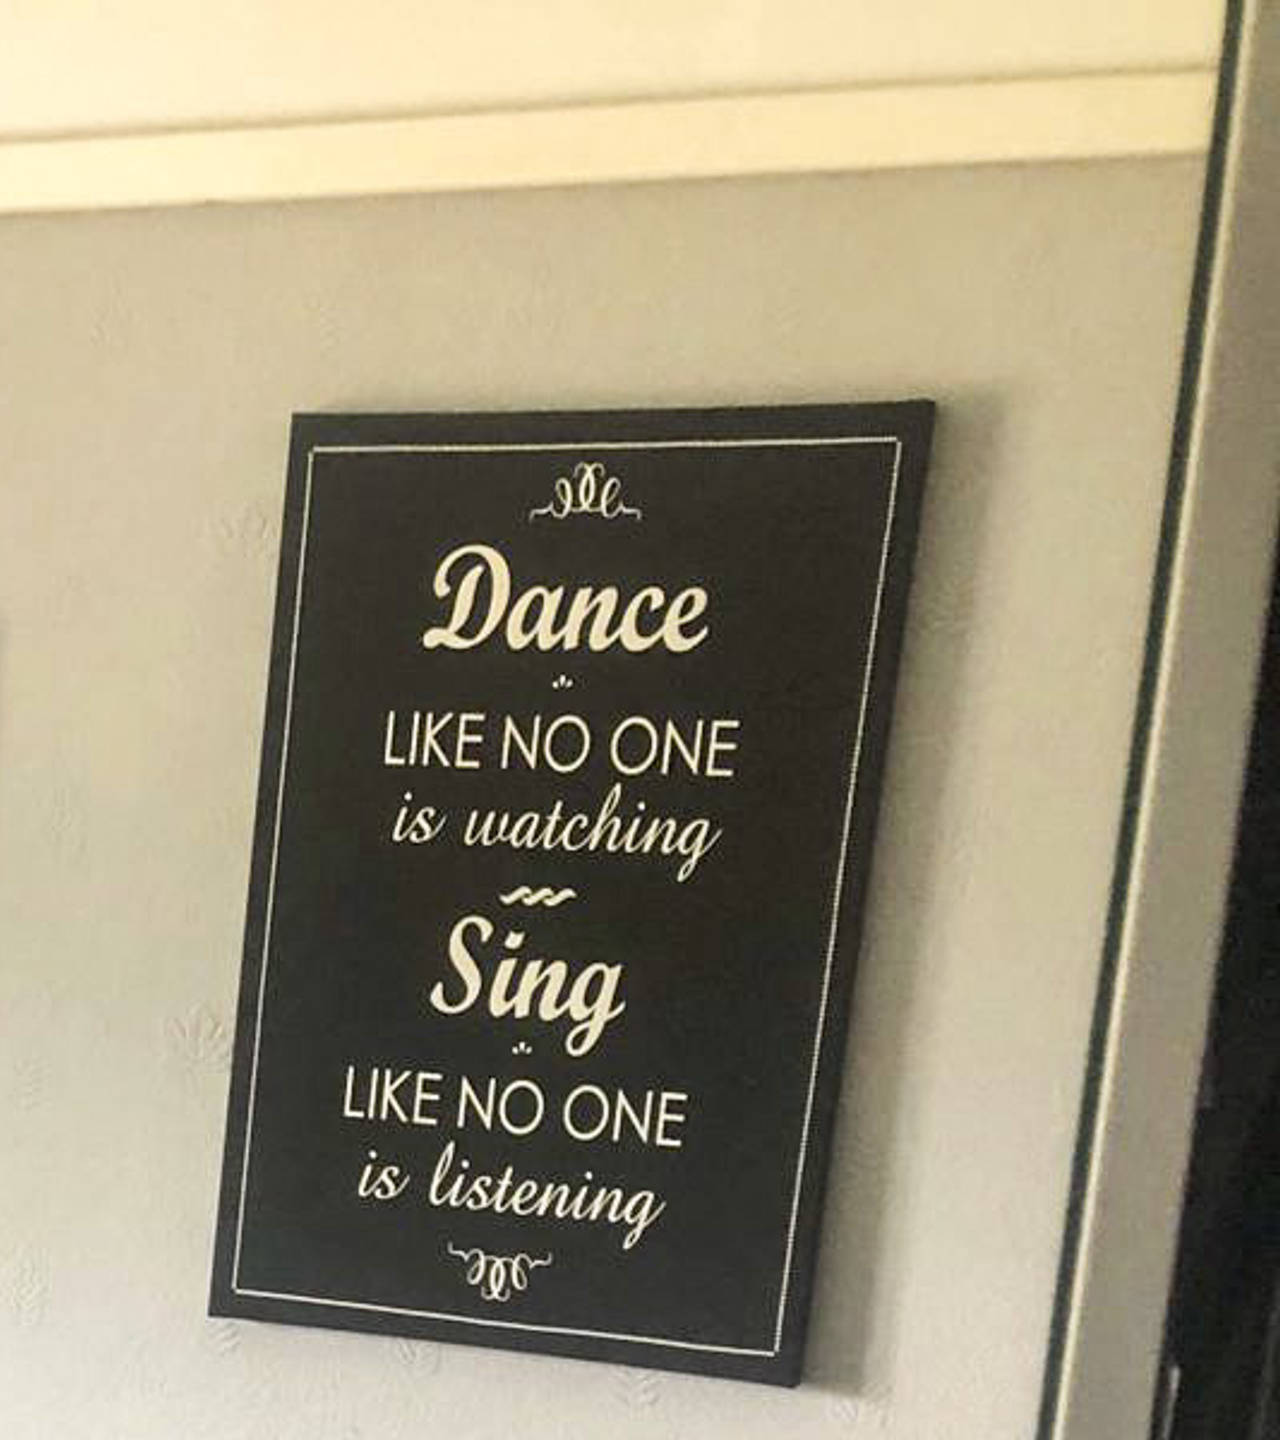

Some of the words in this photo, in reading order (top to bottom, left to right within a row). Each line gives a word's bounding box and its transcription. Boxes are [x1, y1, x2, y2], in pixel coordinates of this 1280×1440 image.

[423, 545, 708, 652] Dance
[385, 711, 485, 768] LIKE
[501, 715, 590, 773] NO
[611, 716, 739, 776] ONE
[393, 792, 446, 844] is
[464, 783, 721, 882] watching
[430, 916, 625, 1056] Sing
[344, 1066, 442, 1125] LIKE
[457, 1076, 544, 1135] NO
[563, 1085, 688, 1146] ONE
[358, 1150, 410, 1200] is
[429, 1141, 666, 1249] listening
